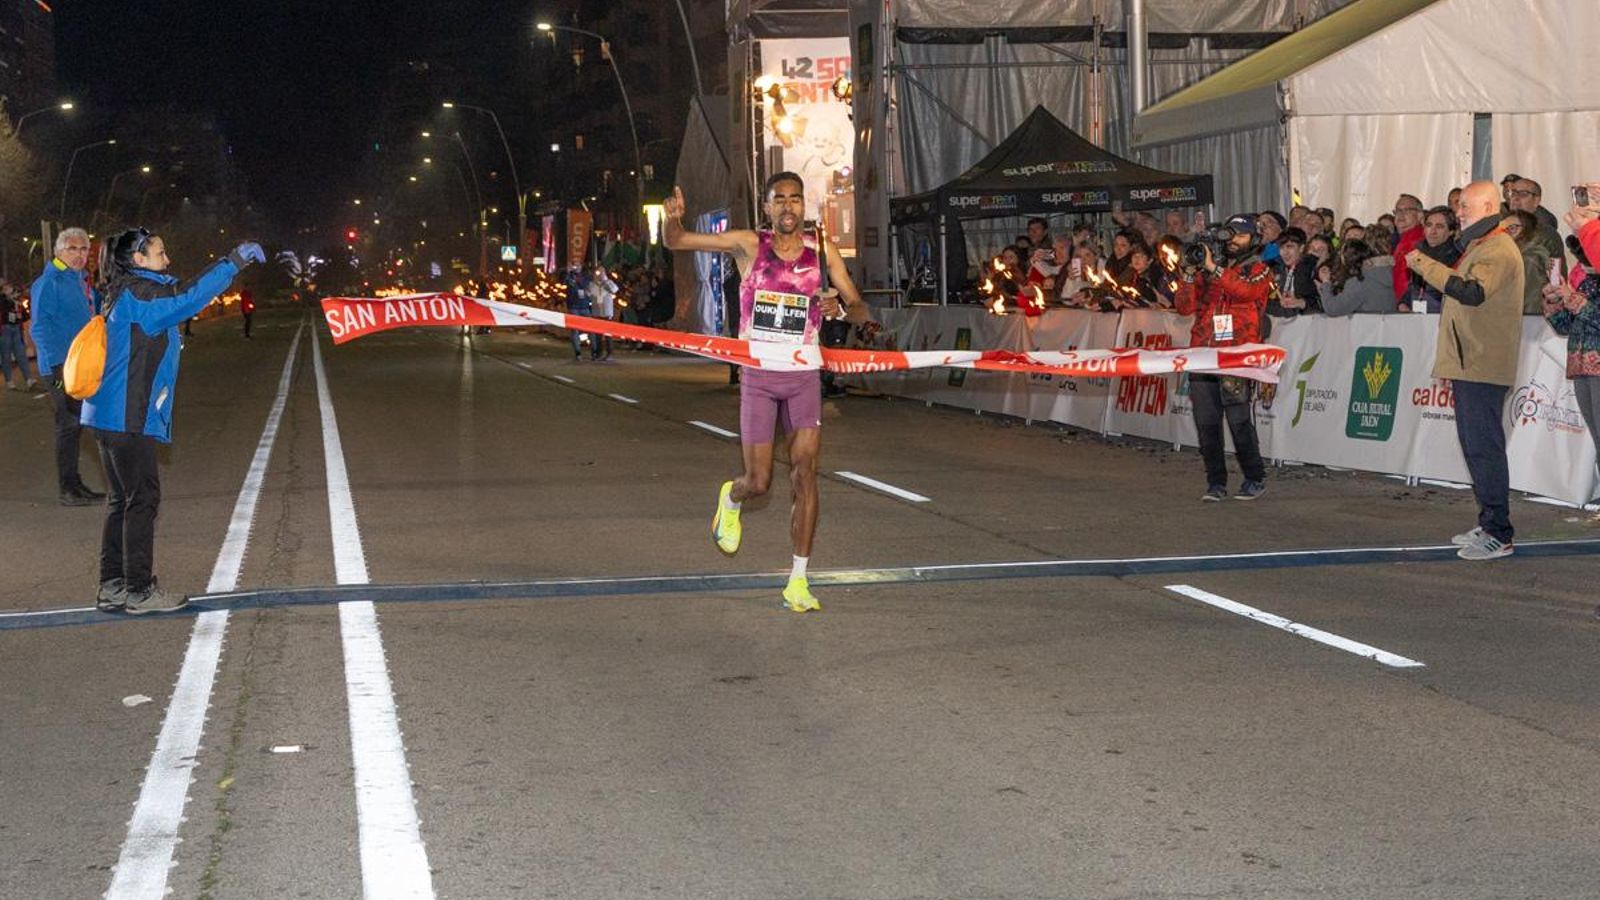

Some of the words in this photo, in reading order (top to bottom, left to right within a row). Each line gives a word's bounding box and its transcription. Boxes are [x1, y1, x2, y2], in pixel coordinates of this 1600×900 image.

[781, 56, 813, 79] 42
[325, 302, 377, 338] SAN
[384, 295, 467, 324] ANTÓN
[755, 304, 806, 319] OUKHLFEN
[1351, 401, 1369, 413] CAJA
[1369, 403, 1393, 416] RURAL
[1360, 414, 1380, 428] JAÉN
